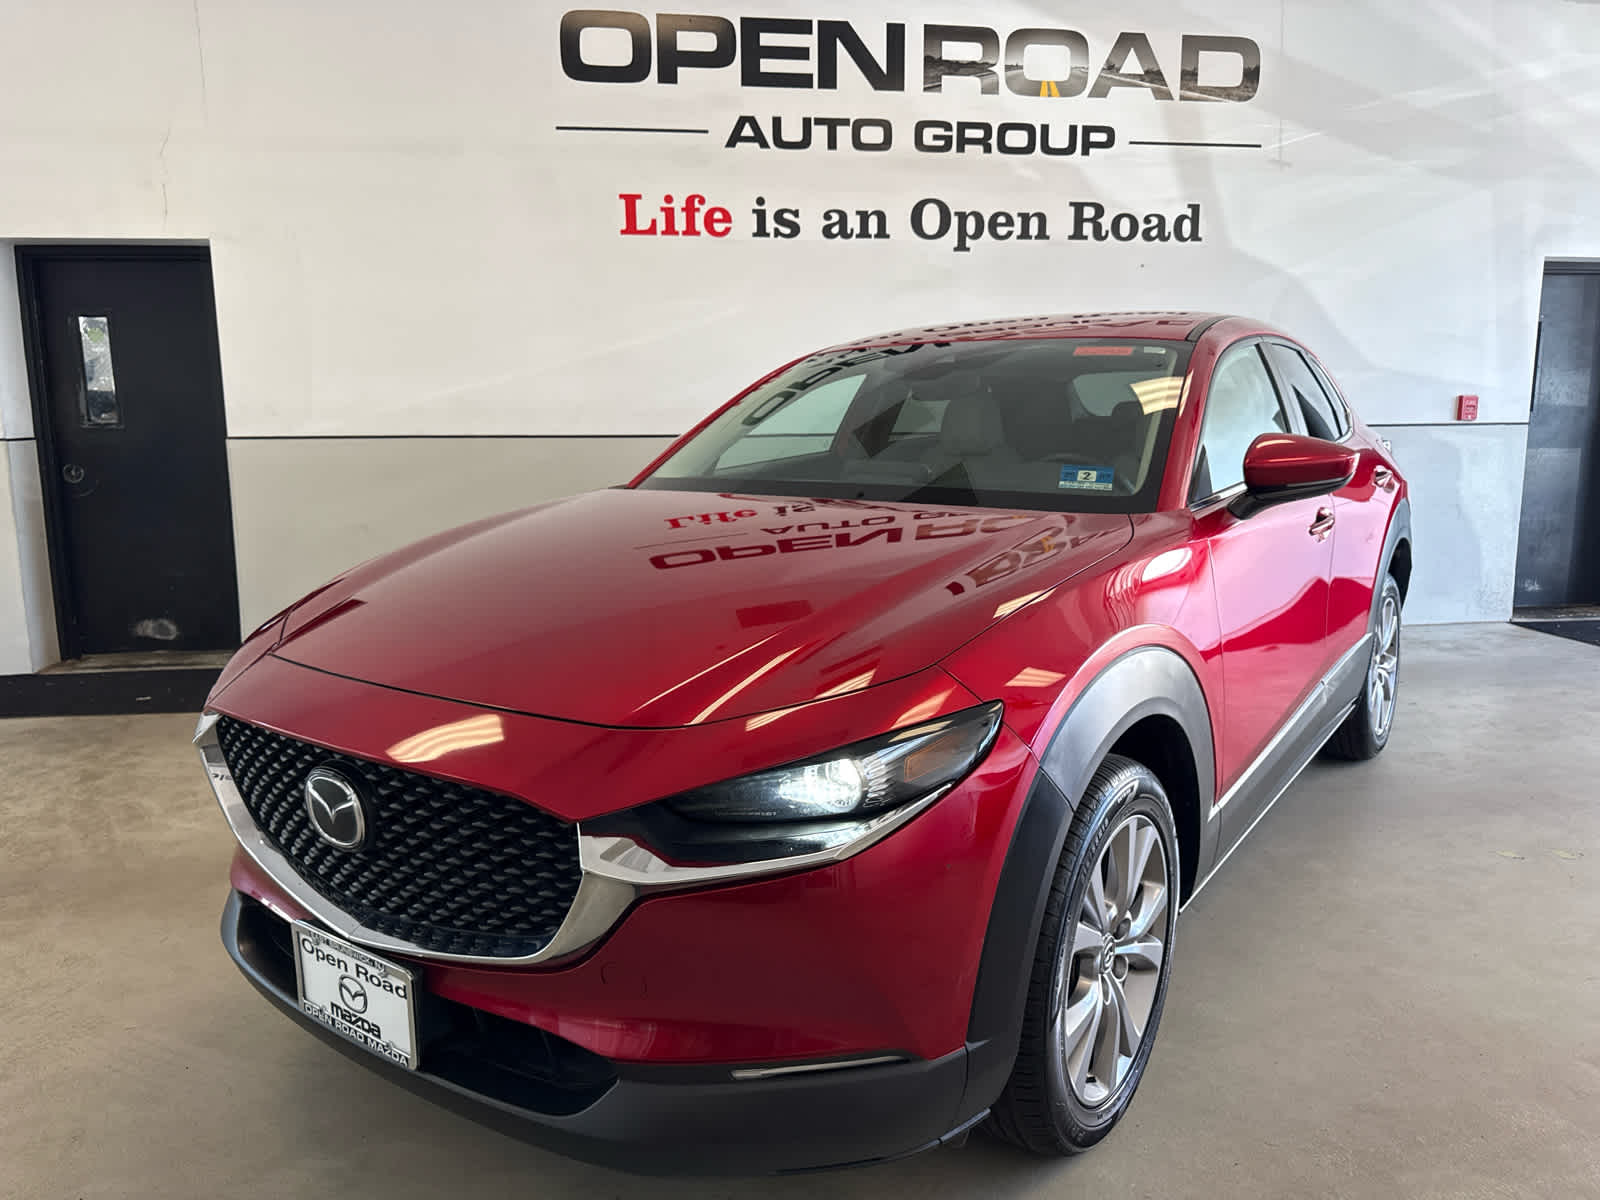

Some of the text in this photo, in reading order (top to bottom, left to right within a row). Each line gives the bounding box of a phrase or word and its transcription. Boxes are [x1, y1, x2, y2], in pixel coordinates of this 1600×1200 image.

[560, 10, 1260, 102] OPEN ROAD
[725, 116, 1115, 156] AUTO GROUP
[619, 194, 1202, 252] Life is an Open Road
[301, 937, 349, 973] Open
[355, 963, 408, 1000] Road
[305, 1003, 409, 1067] OPEN ROAD MAZDA
